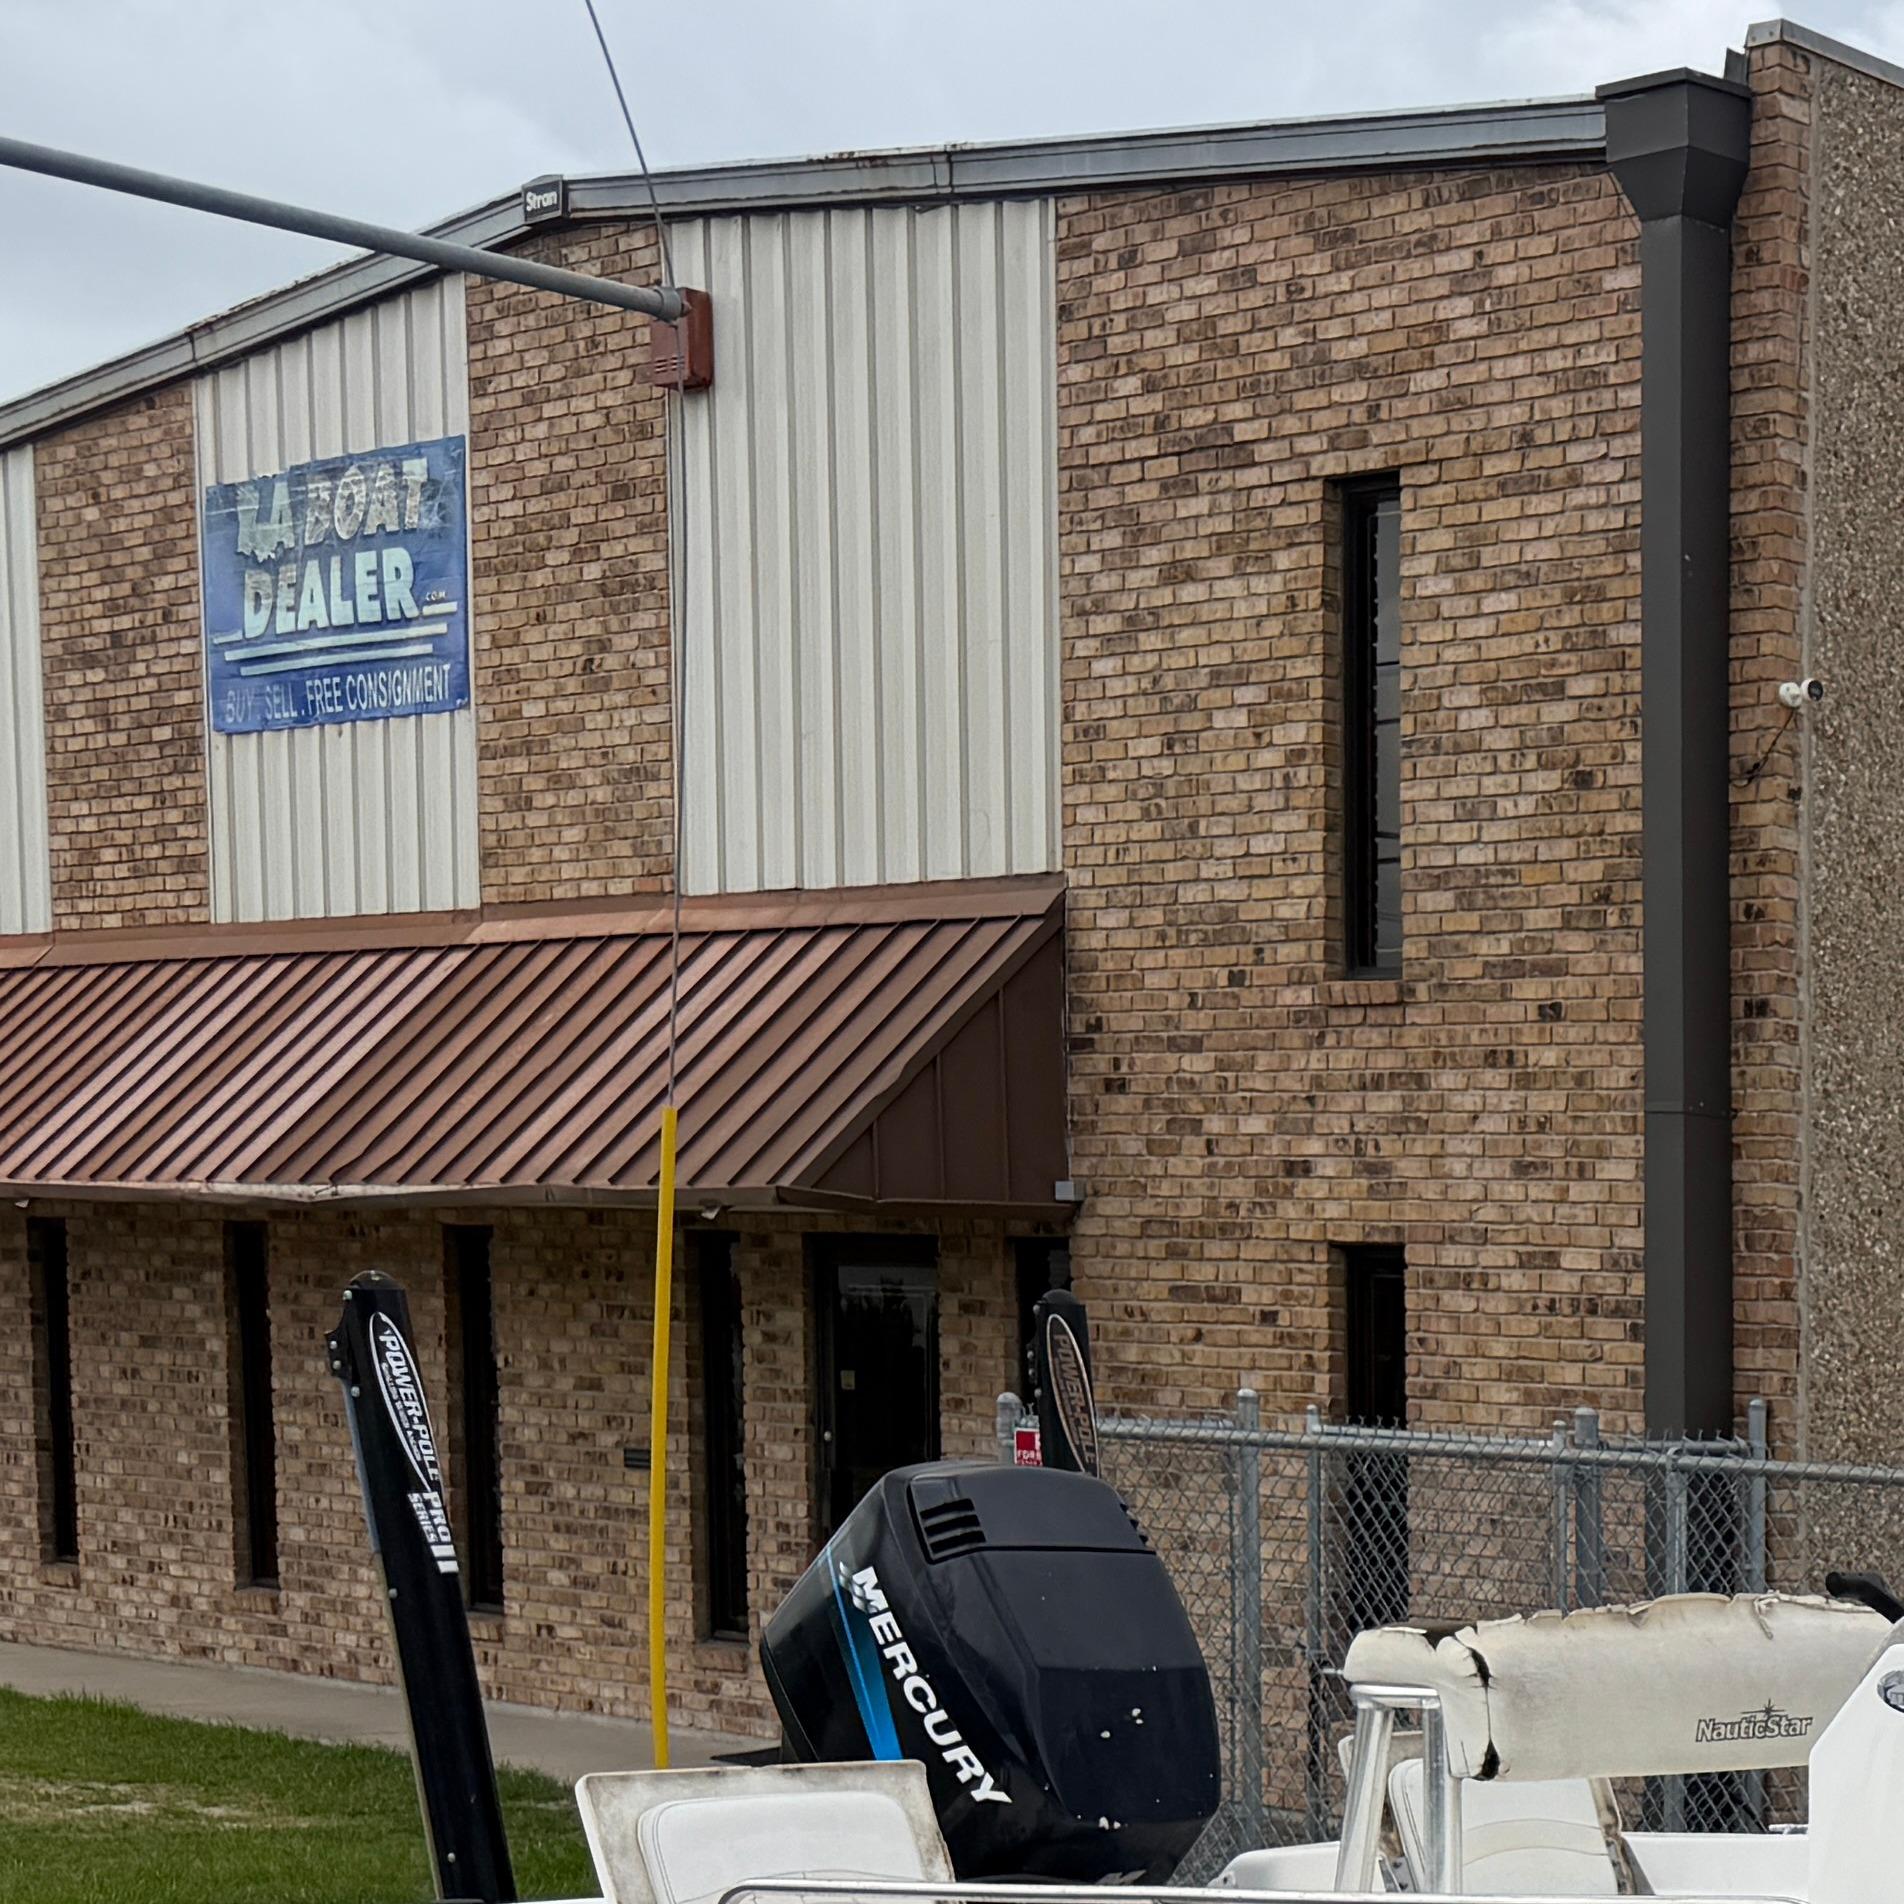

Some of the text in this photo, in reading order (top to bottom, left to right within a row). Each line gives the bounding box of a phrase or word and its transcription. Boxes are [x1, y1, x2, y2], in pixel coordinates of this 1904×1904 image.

[244, 547, 419, 639] DEALER
[305, 677, 344, 717] FREE
[346, 664, 451, 711] CONSIGNMENT
[378, 1334, 441, 1481] POWER-POLE
[1053, 1333, 1096, 1464] POWER-POLE
[407, 1493, 438, 1544] SERIES
[422, 1491, 452, 1543] PRO
[851, 1565, 1013, 1804] MERCURY
[1695, 1715, 1813, 1742] NauticStar
